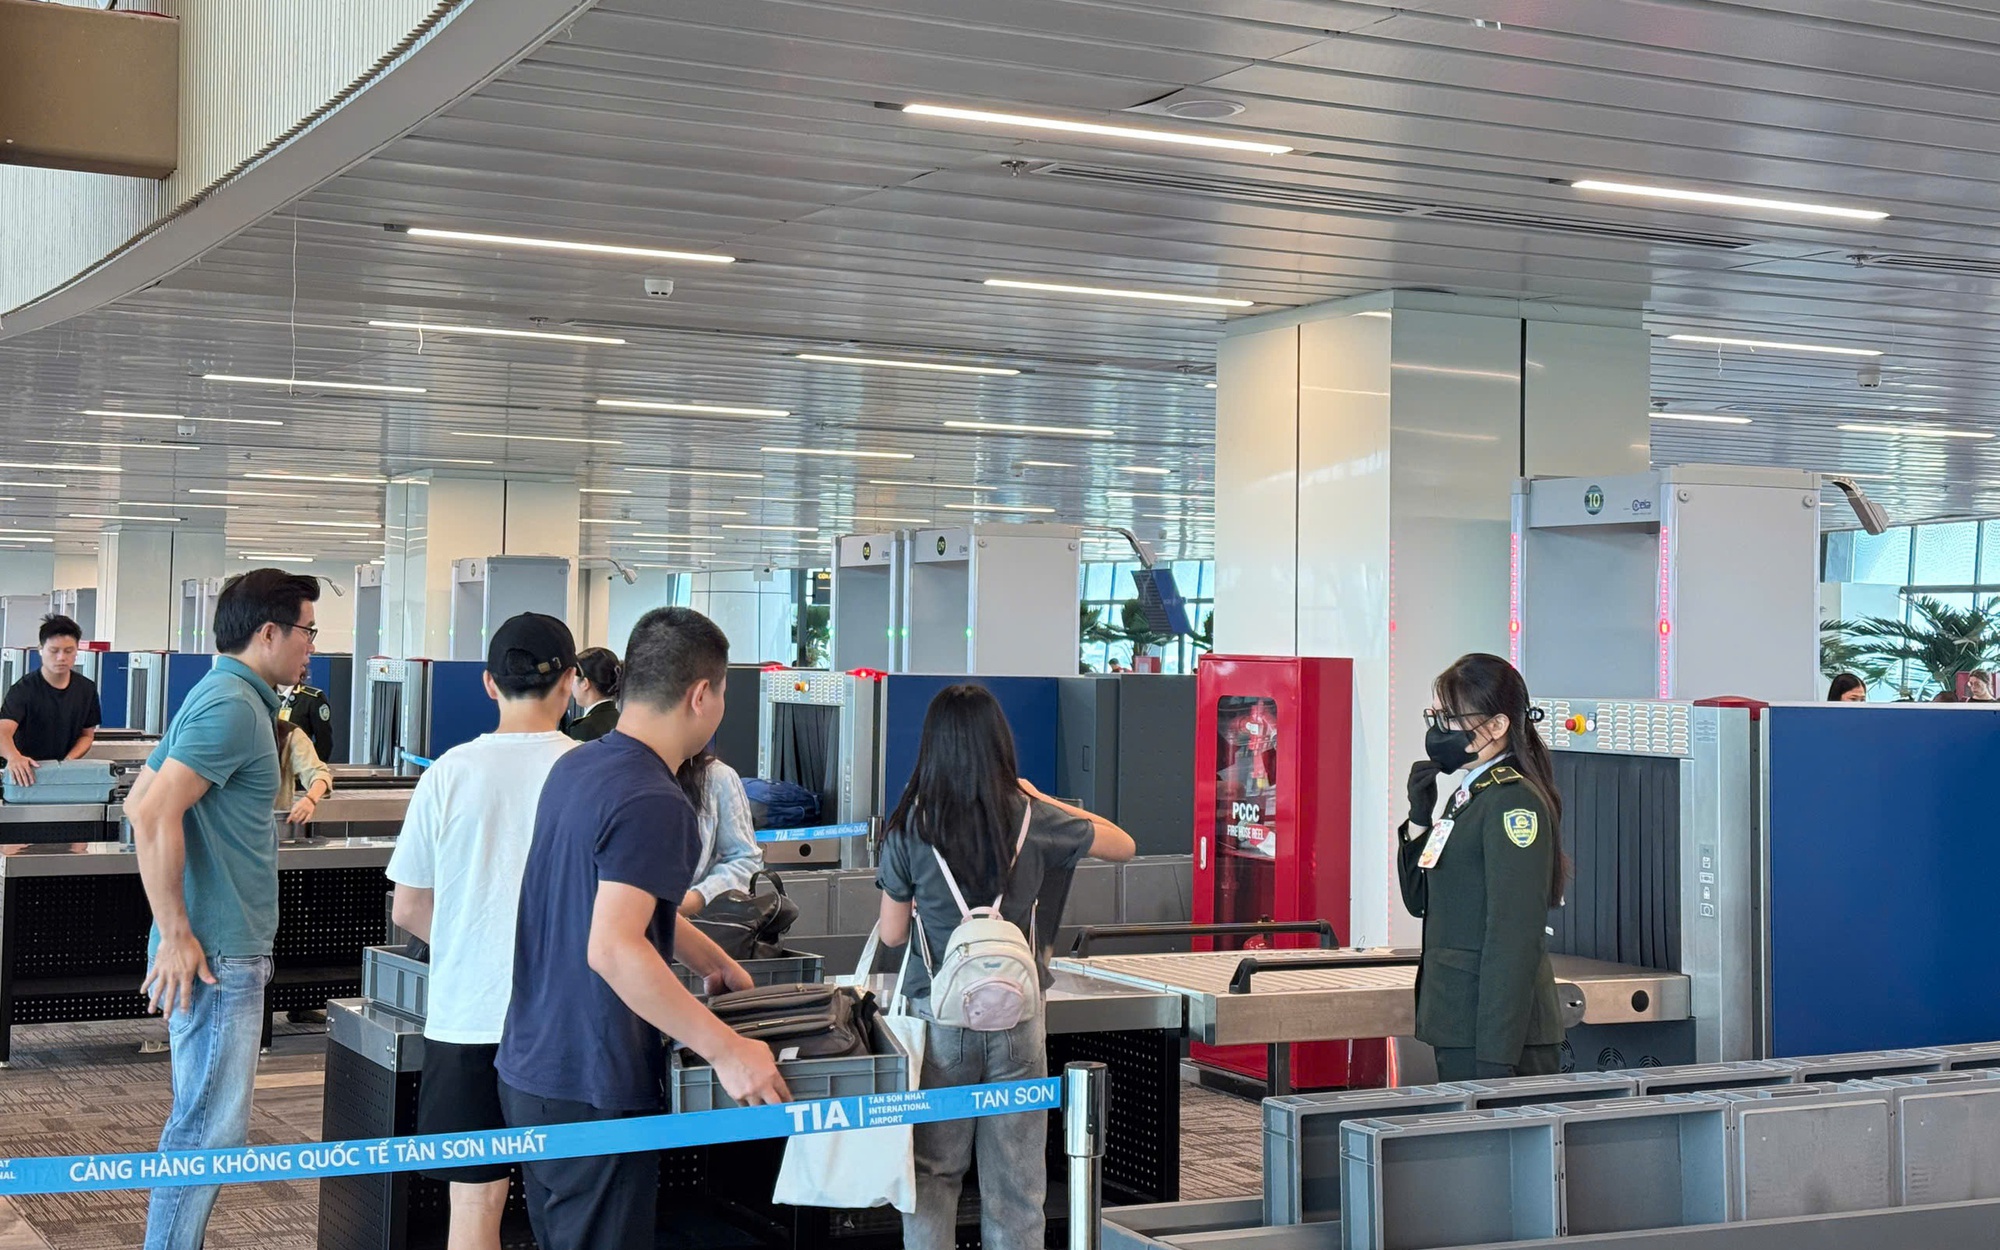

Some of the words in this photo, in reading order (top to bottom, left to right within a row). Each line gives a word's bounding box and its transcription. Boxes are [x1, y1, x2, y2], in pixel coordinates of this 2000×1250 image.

[1588, 493, 1601, 508] 10
[1232, 802, 1260, 822] PCCC
[868, 1096, 885, 1105] TAN
[886, 1094, 903, 1103] SON
[904, 1092, 927, 1101] NHAT
[971, 1088, 1009, 1110] TAN
[1014, 1083, 1055, 1105] SON
[785, 1100, 851, 1133] TIA
[868, 1102, 932, 1115] INTERNATIONAL
[869, 1115, 904, 1126] AIRPORT
[69, 1155, 133, 1182] CẢNG
[140, 1153, 205, 1178] HÀNG
[212, 1148, 292, 1175] KHÔNG
[298, 1142, 360, 1171] QUỐC
[365, 1140, 390, 1166] TẾ
[394, 1139, 436, 1164] TÂN
[442, 1137, 485, 1160] SƠN
[492, 1129, 548, 1156] NHẤT
